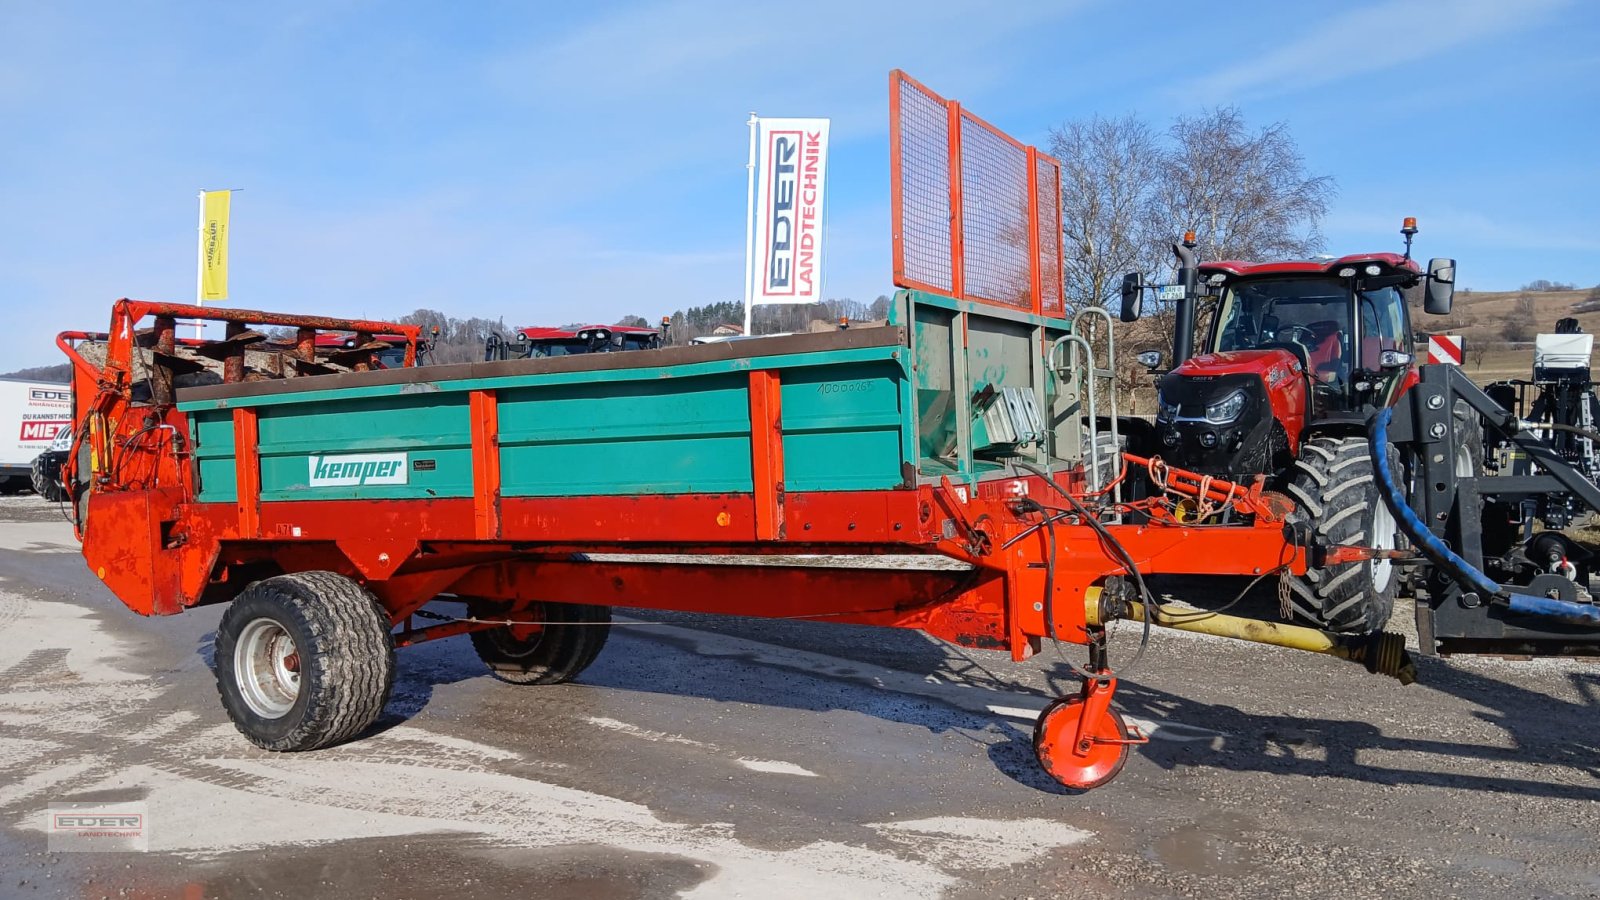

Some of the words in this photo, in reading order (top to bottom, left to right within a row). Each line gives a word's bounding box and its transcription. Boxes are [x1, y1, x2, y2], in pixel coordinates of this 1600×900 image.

[770, 136, 796, 289] EDER
[800, 129, 821, 296] LANDTECHNIK
[208, 222, 216, 268] HUMBAUR
[32, 390, 72, 400] EDE
[313, 456, 402, 484] kemper
